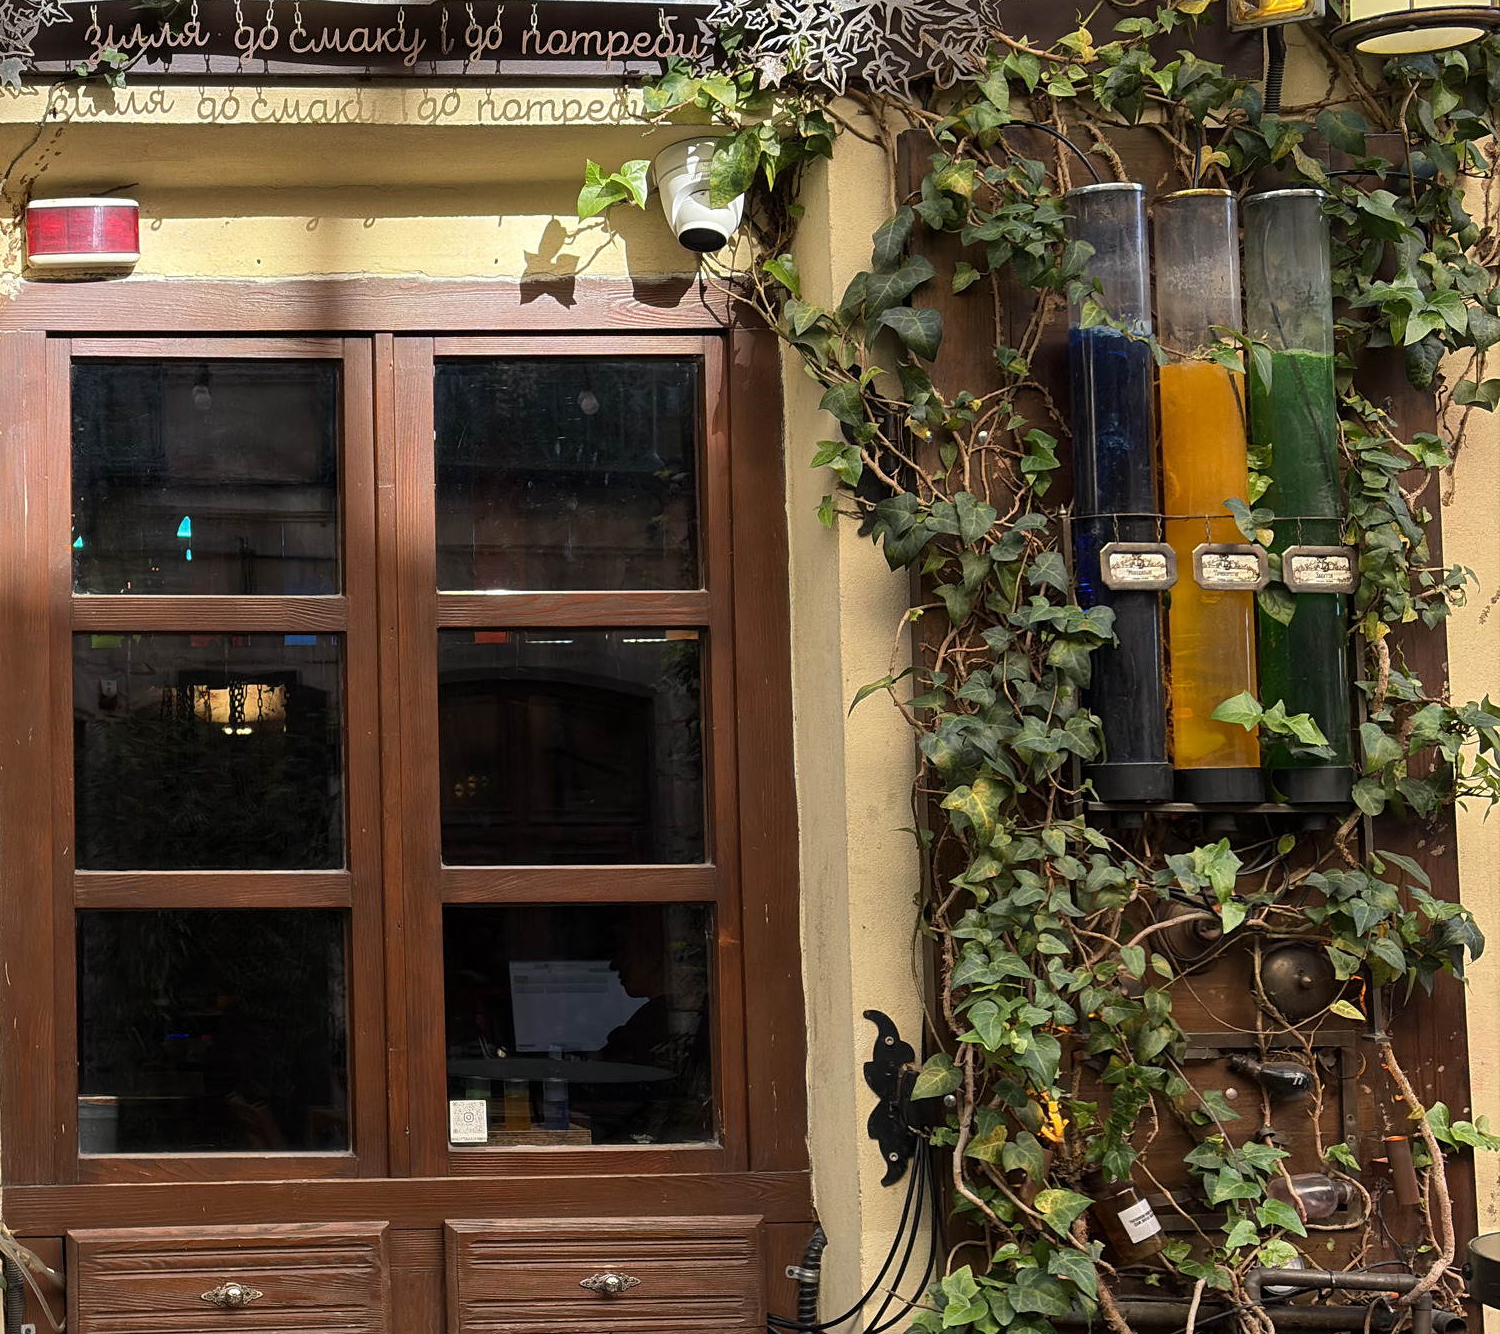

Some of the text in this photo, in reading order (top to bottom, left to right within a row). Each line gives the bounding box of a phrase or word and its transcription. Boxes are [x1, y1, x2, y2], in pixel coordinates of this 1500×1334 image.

[233, 24, 280, 65] до
[288, 24, 426, 67] смаку
[463, 23, 503, 64] до
[520, 16, 708, 70] потреби
